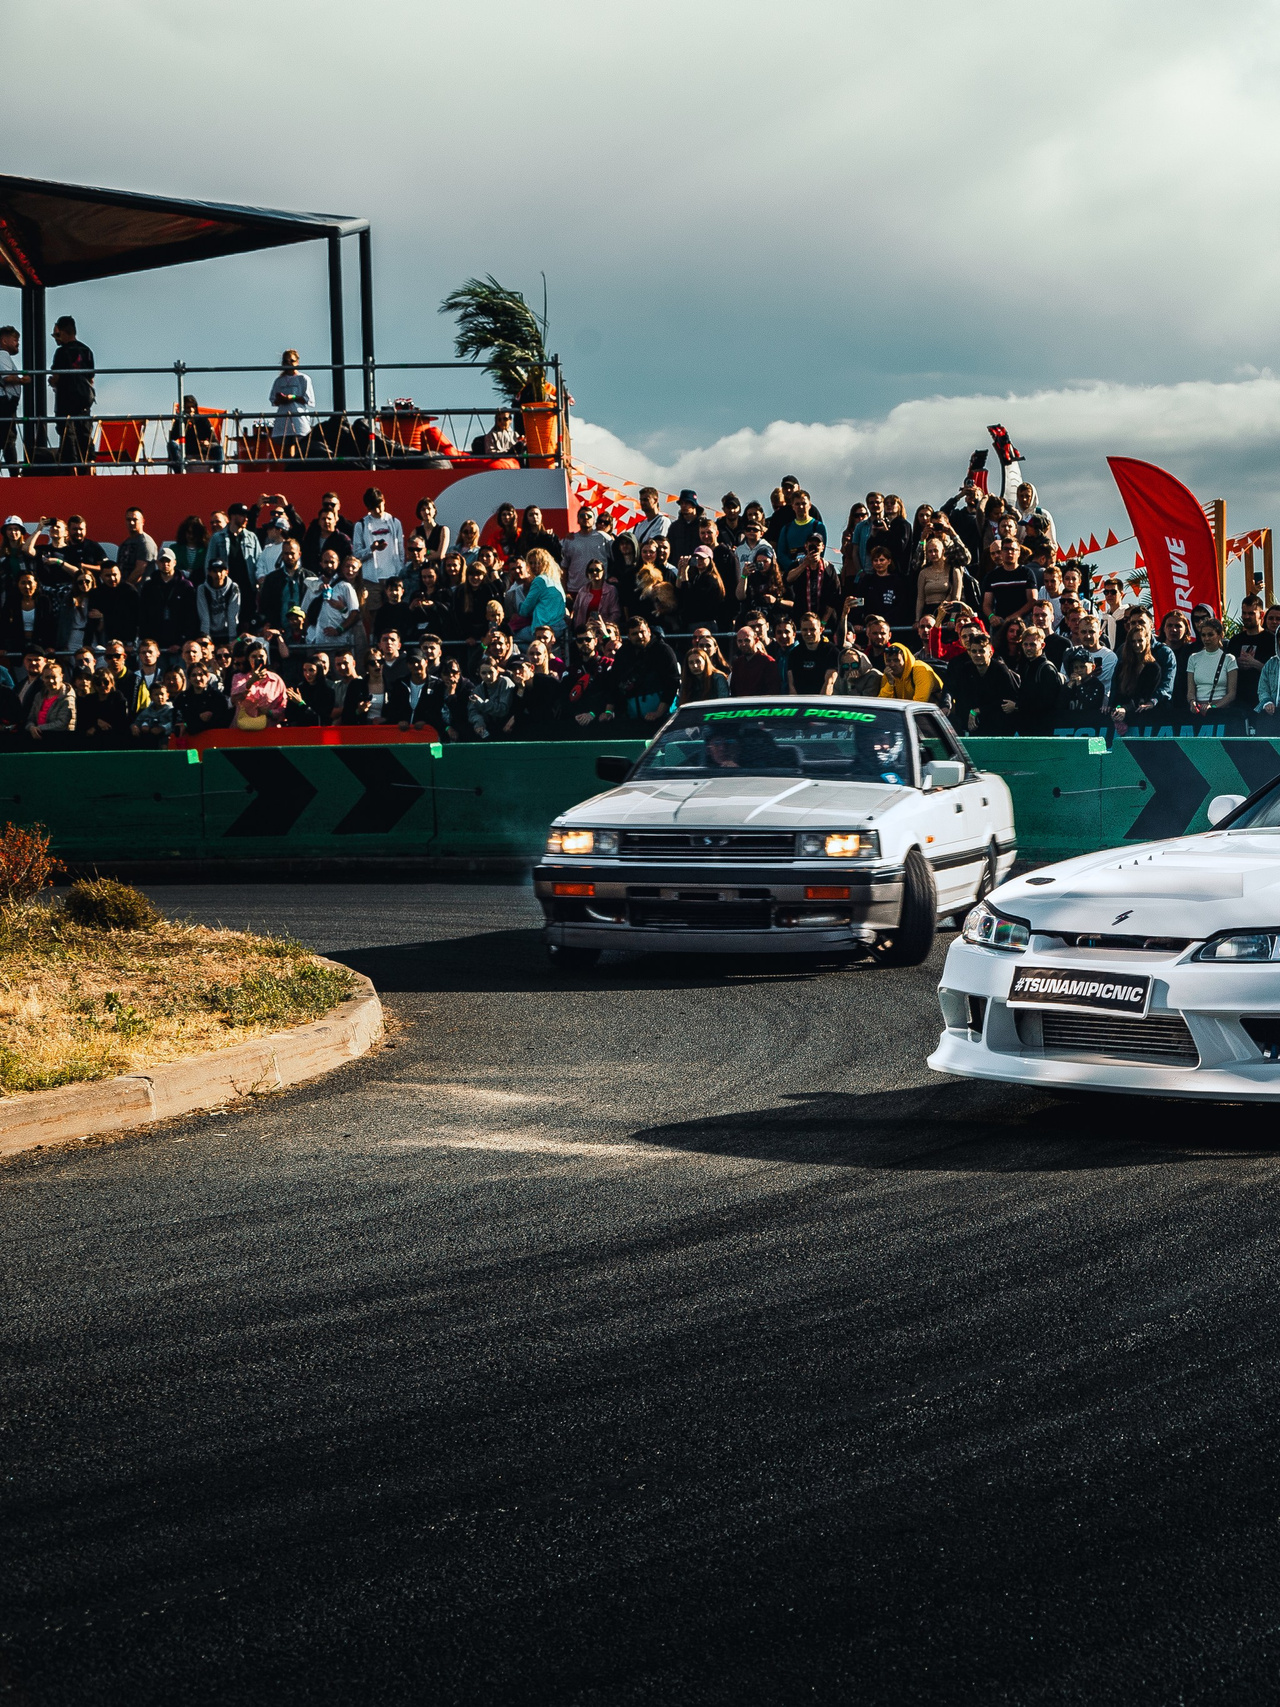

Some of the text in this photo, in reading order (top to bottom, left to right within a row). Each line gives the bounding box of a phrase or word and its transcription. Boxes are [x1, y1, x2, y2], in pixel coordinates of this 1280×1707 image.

[703, 708, 877, 723] TSUNAMI PICNIC
[1014, 977, 1144, 1002] #TSUNAMIPICNIC
